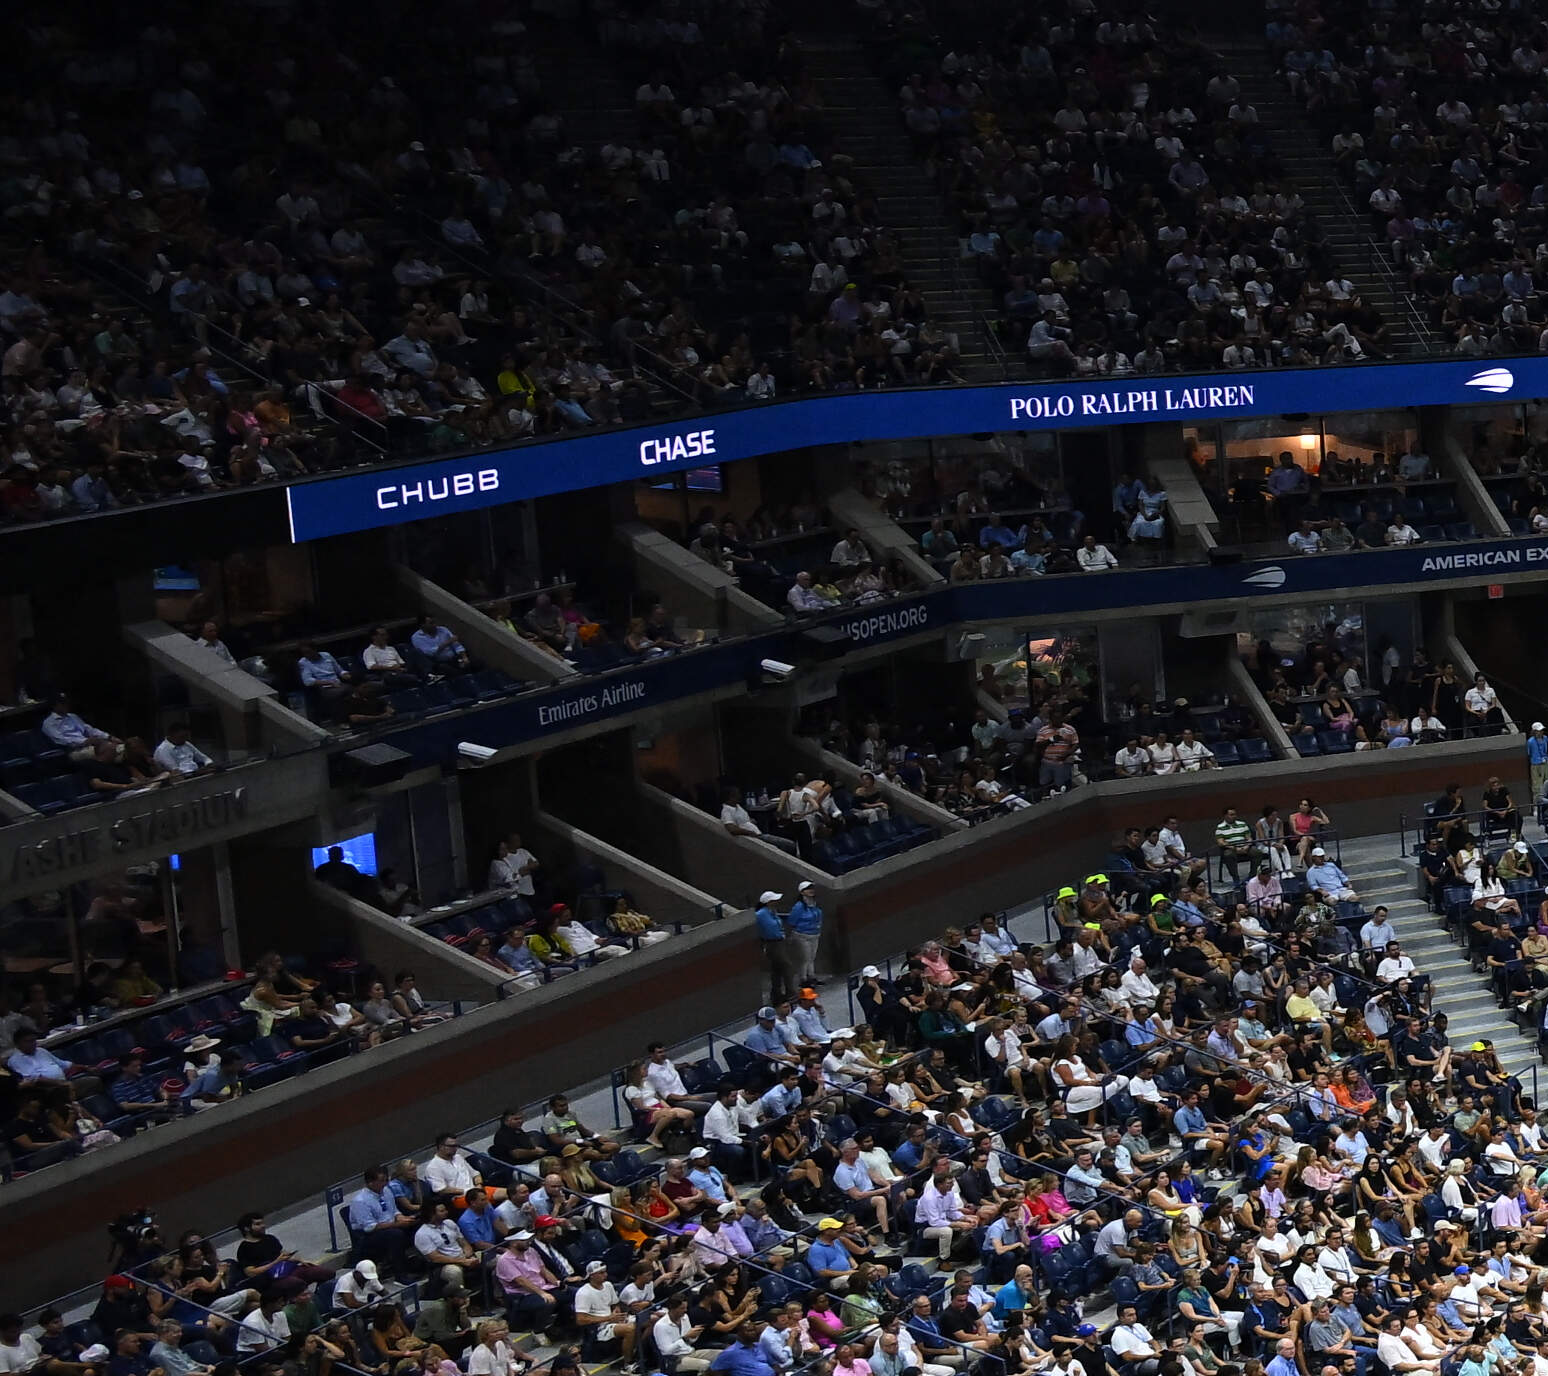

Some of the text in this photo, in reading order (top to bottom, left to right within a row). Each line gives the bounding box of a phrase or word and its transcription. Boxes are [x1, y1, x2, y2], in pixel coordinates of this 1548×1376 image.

[1010, 385, 1254, 420] POLO RALPH LAUREN
[639, 429, 717, 469] CHASE
[376, 468, 500, 510] CHUBB
[1420, 547, 1521, 572] AMERICAN
[537, 681, 645, 725] Emirates Airline
